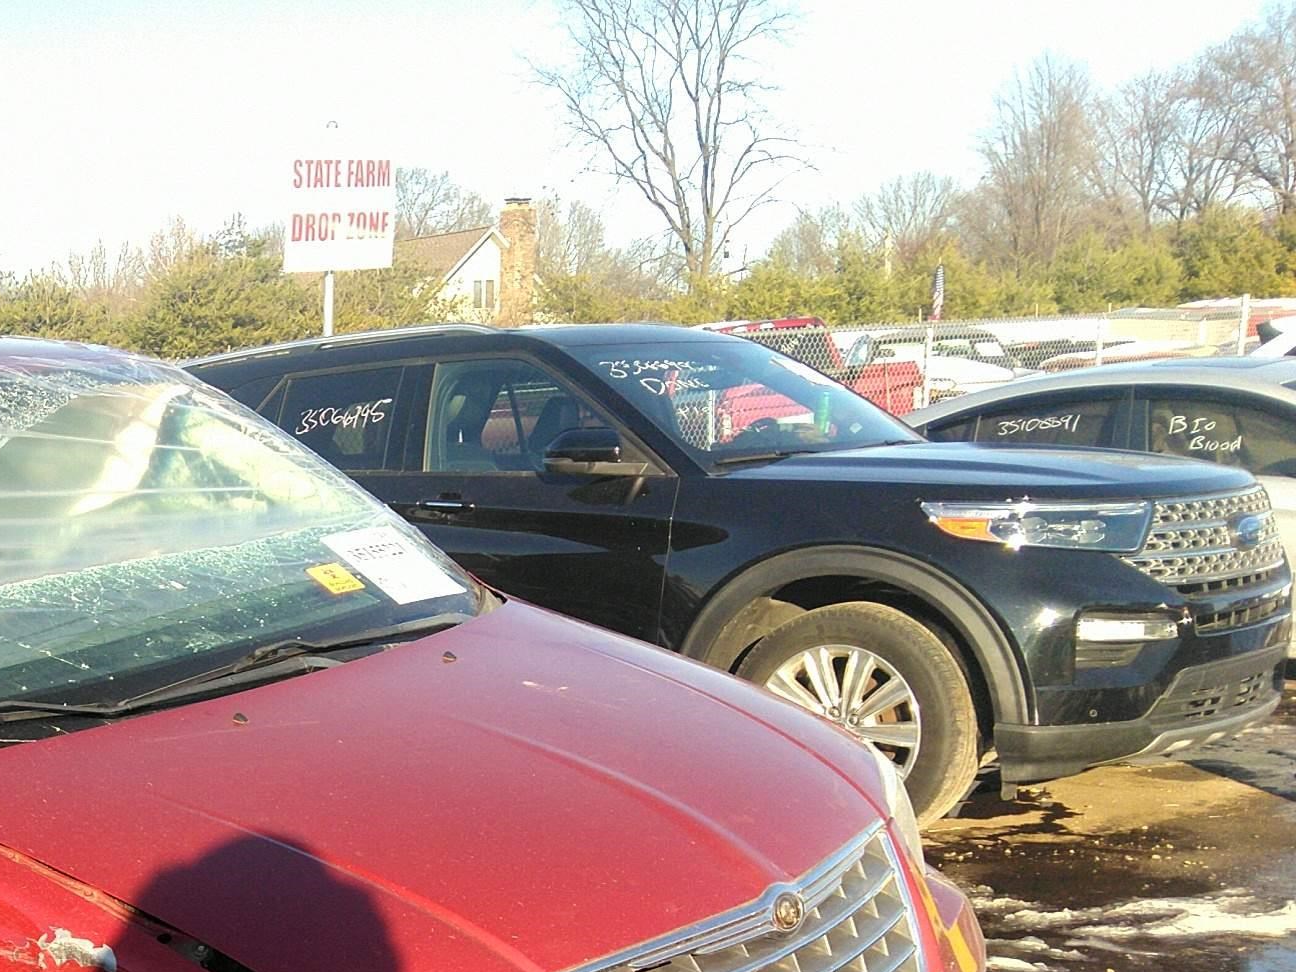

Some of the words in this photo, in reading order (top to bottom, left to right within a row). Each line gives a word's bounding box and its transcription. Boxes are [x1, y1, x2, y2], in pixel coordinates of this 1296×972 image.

[293, 159, 342, 189] STATE
[347, 159, 391, 188] FARM
[291, 212, 342, 242] DROP
[346, 211, 389, 240] ZONE
